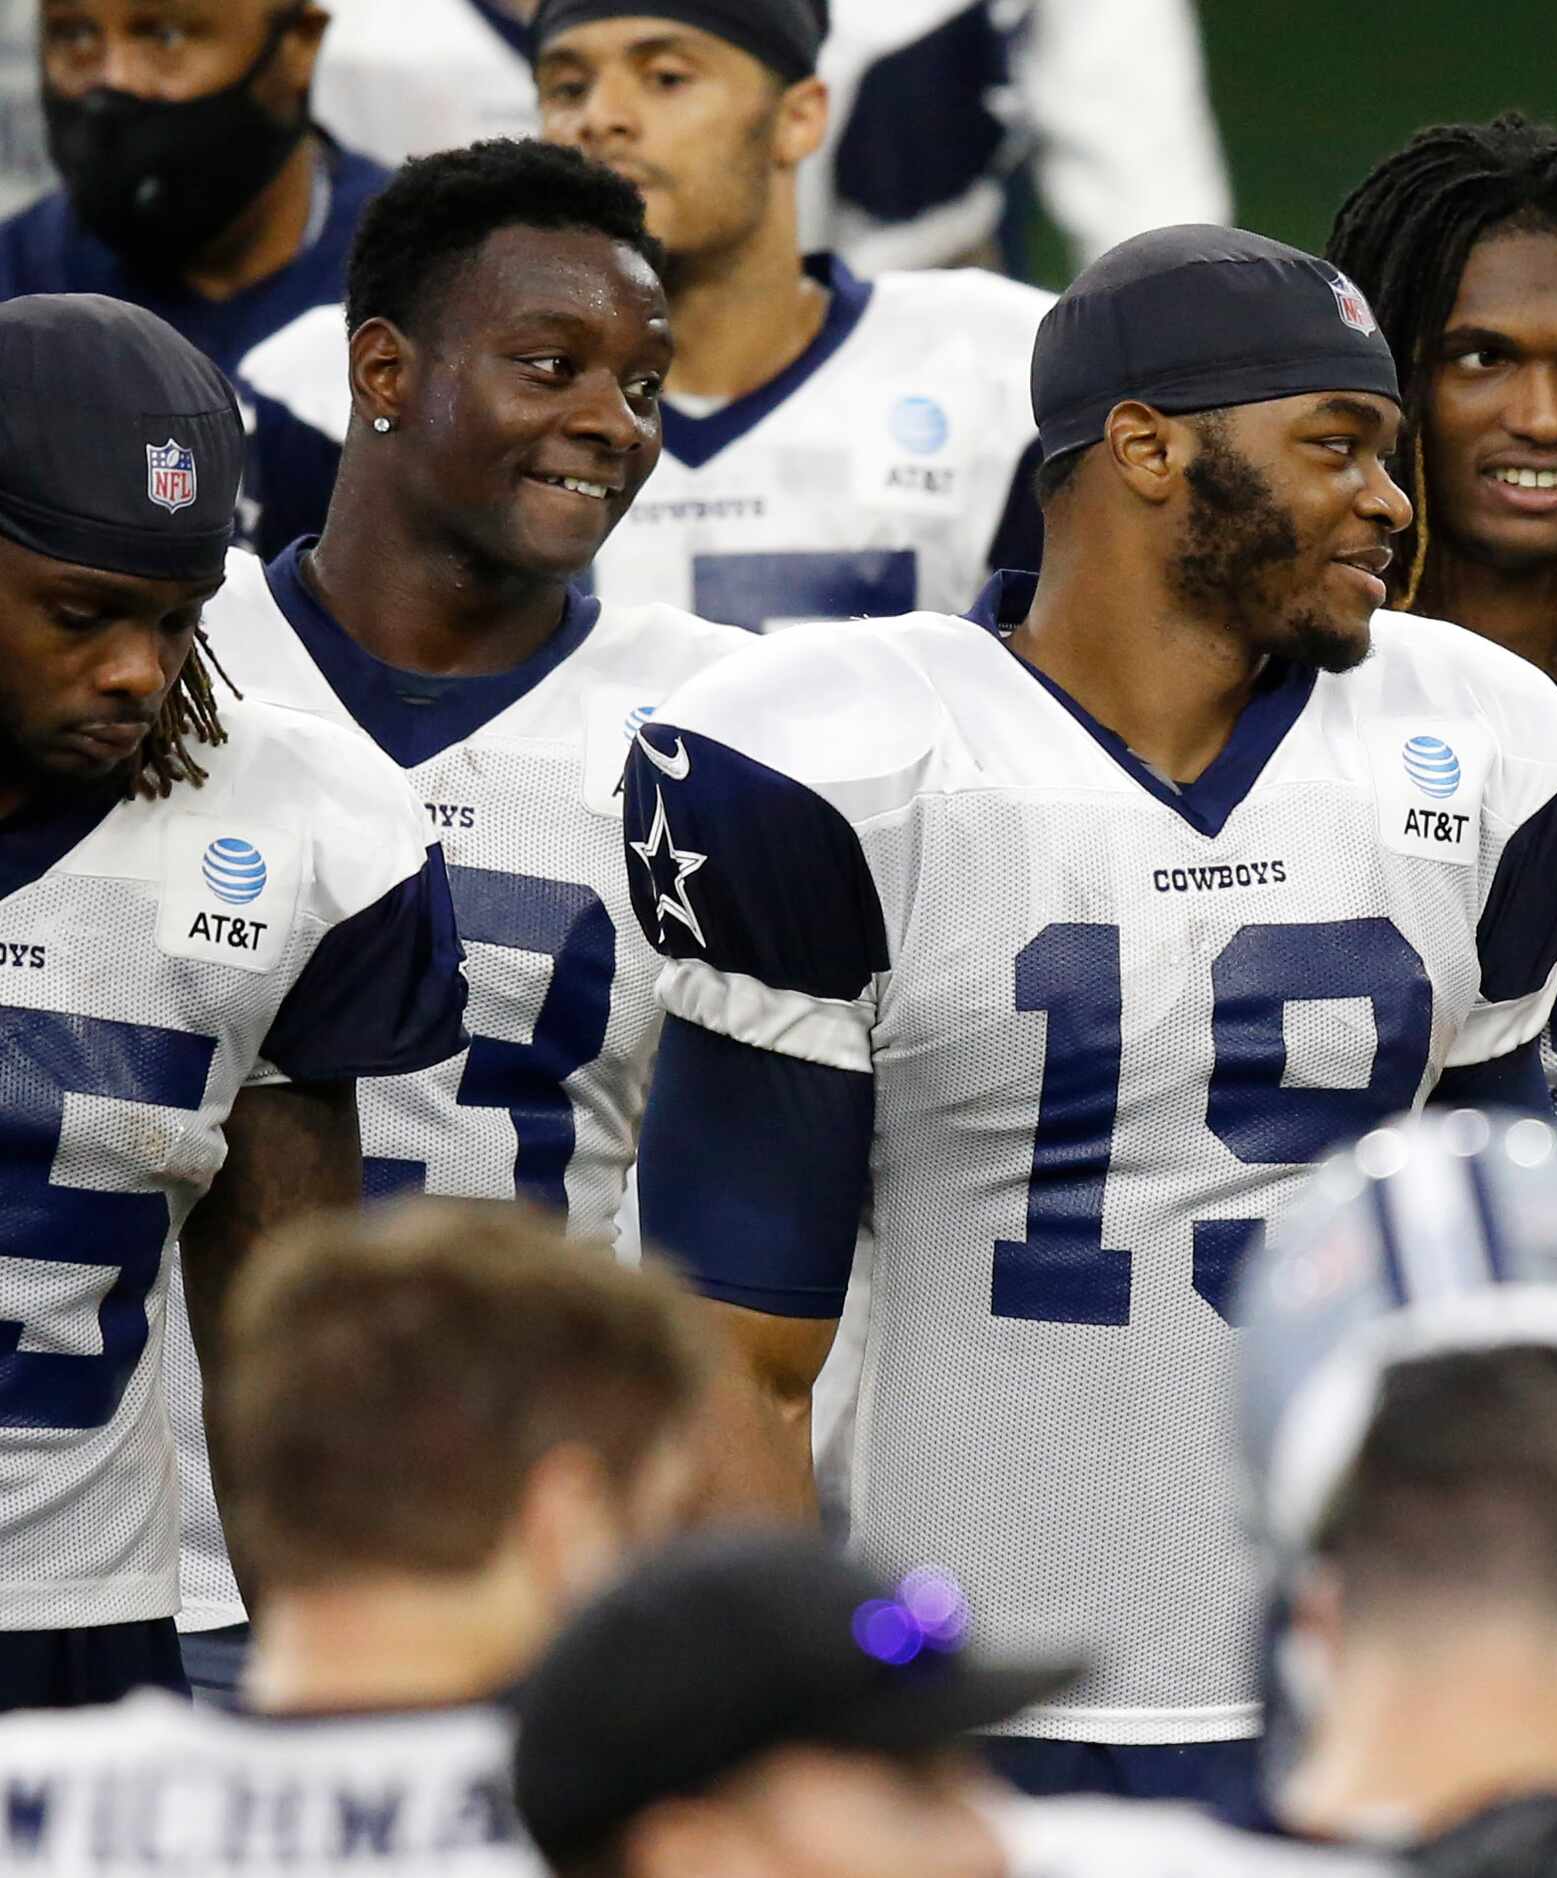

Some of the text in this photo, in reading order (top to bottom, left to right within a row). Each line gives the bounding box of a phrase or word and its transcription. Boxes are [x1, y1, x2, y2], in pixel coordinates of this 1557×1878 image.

[155, 471, 191, 502] NFL
[1403, 808, 1470, 844] AT&T
[1153, 860, 1287, 893] COWBOYS
[188, 912, 268, 951] AT&T
[989, 916, 1434, 1328] 19
